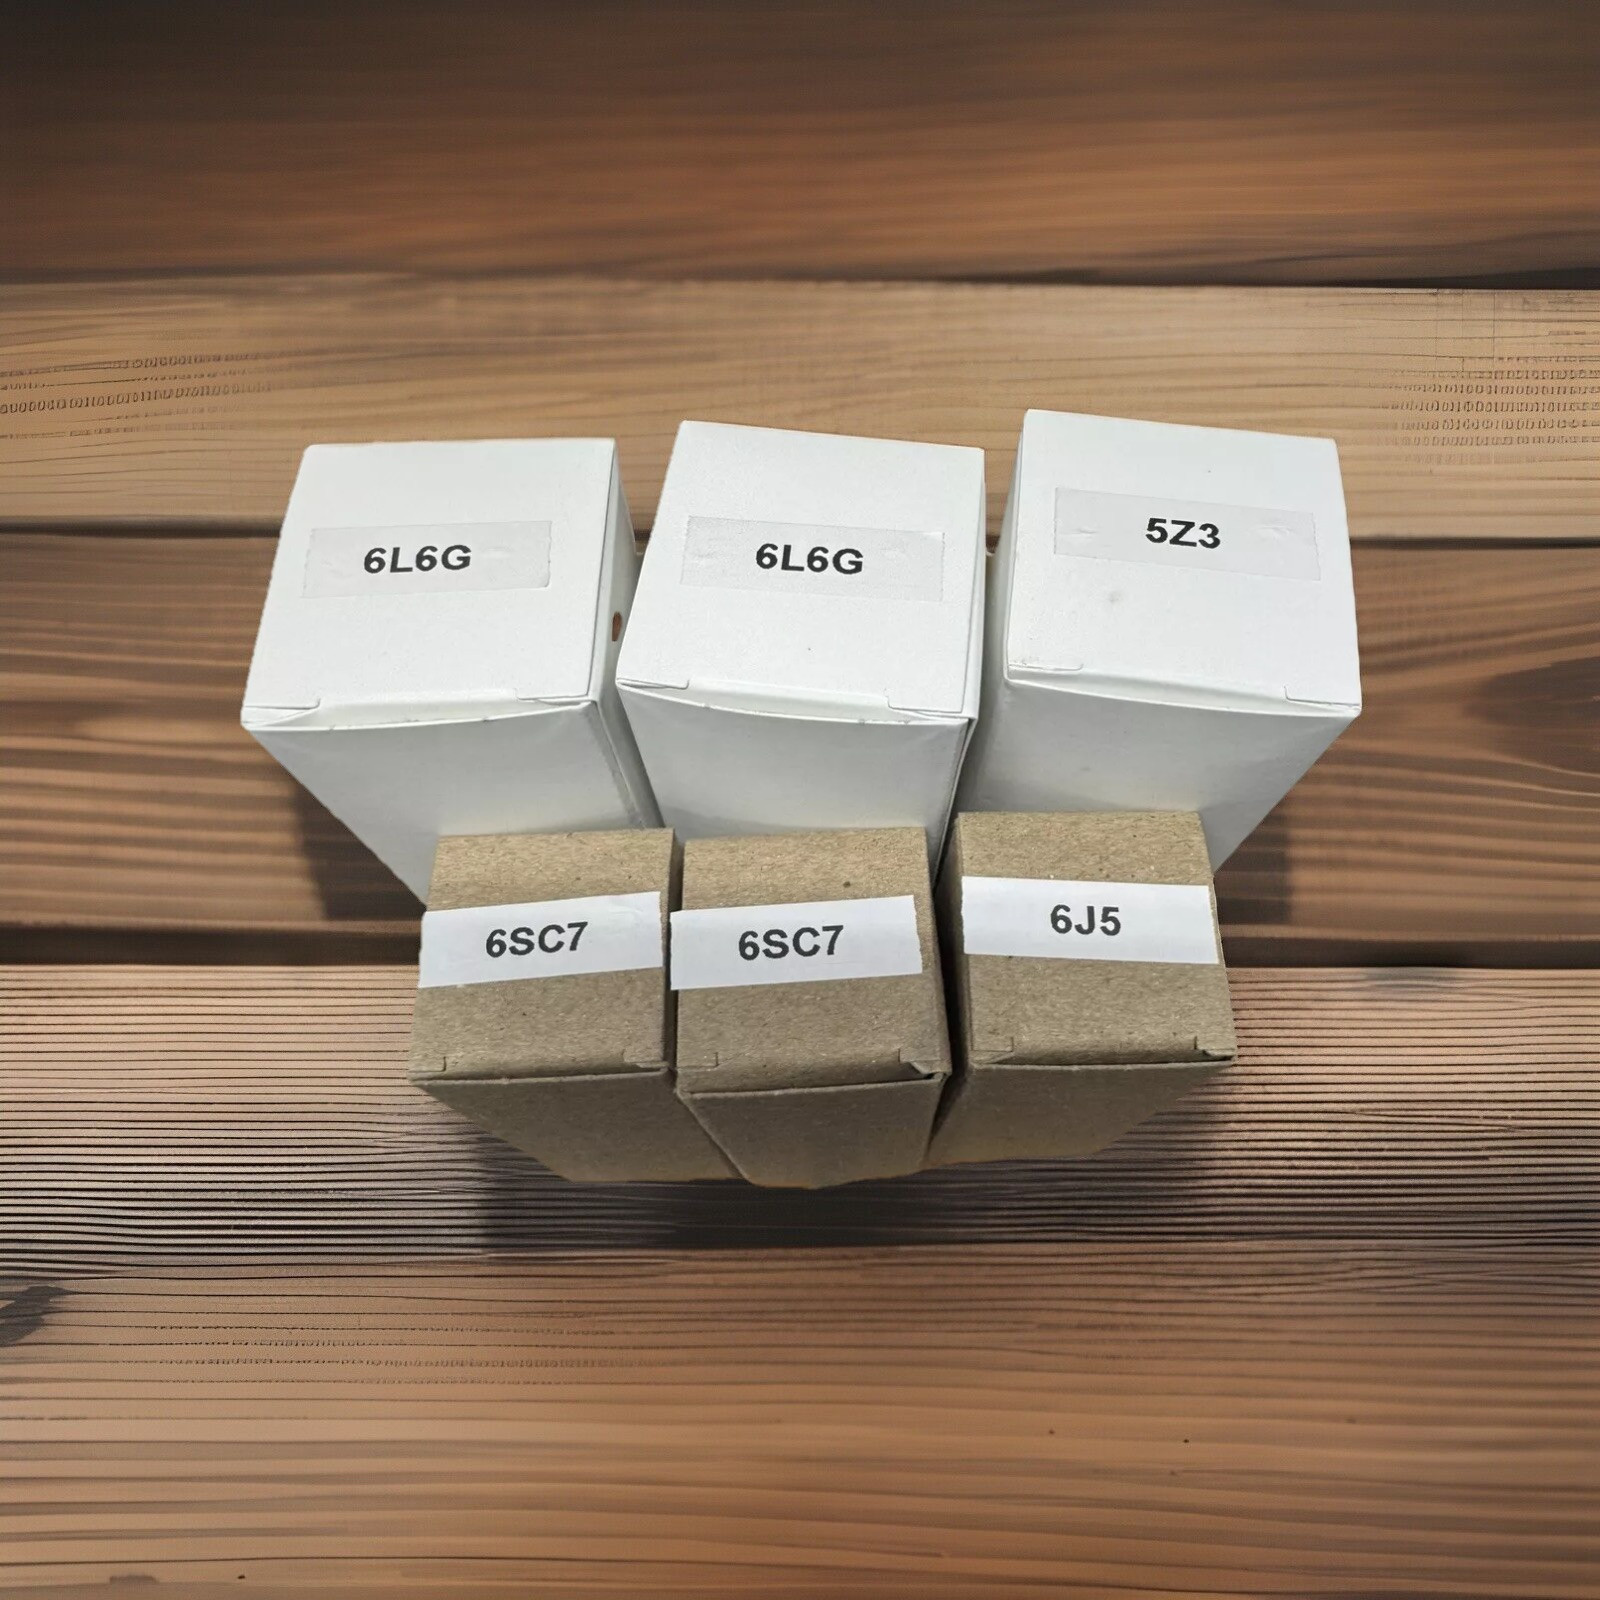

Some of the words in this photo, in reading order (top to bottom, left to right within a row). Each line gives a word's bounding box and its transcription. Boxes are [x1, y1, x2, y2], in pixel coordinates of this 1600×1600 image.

[1145, 517, 1222, 549] 5Z3
[363, 544, 472, 575] 6L6G
[755, 543, 864, 576] 6L6G
[1050, 904, 1121, 936] 6J5
[485, 921, 588, 958] 6SC7
[738, 924, 844, 961] 6SC7
